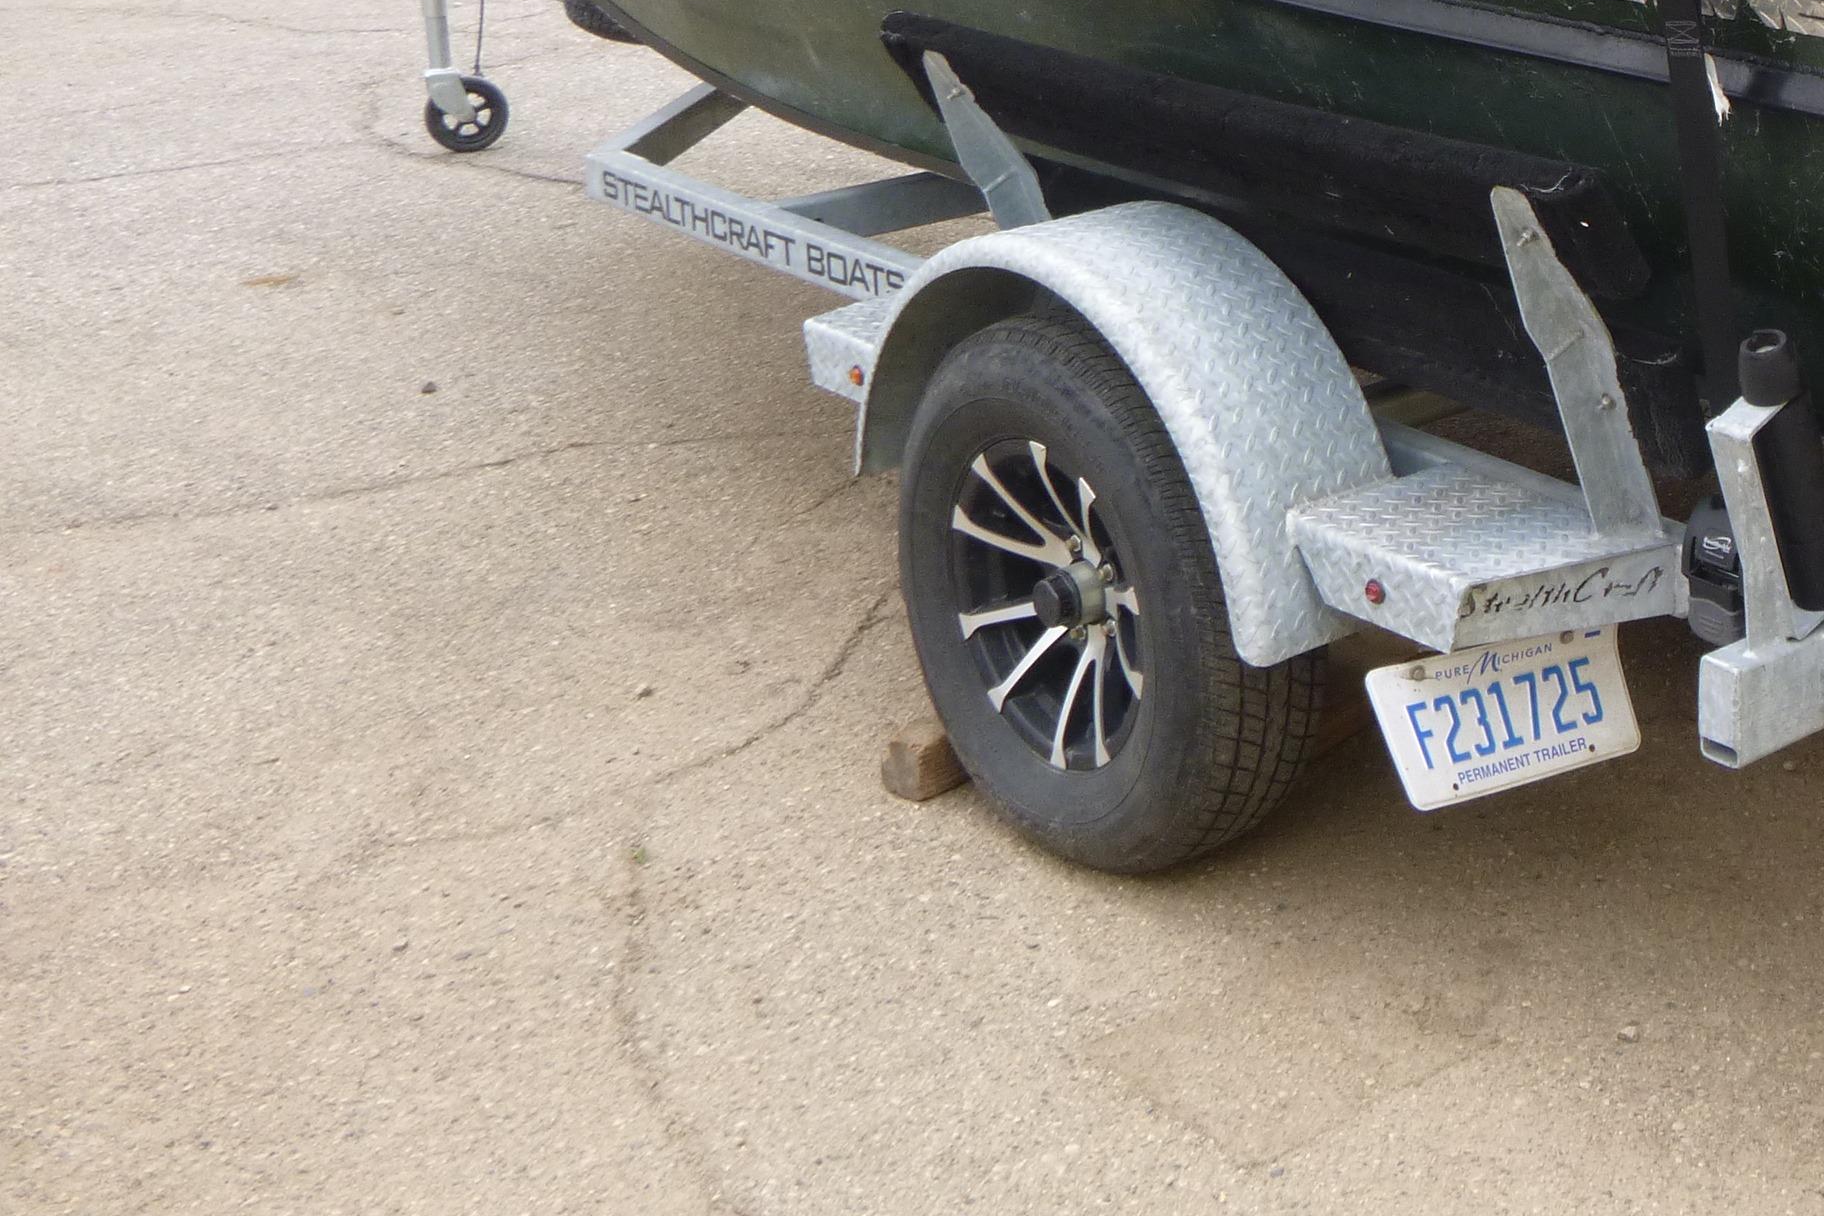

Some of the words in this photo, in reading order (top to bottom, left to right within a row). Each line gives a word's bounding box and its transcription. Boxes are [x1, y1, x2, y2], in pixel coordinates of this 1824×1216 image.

[602, 170, 795, 266] STEALTHCRAFT
[806, 244, 905, 296] BOATS
[1435, 664, 1470, 680] PURE
[1405, 656, 1604, 770] F231725
[1457, 754, 1531, 785] PERMANENT
[1533, 737, 1588, 764] TRAILER
